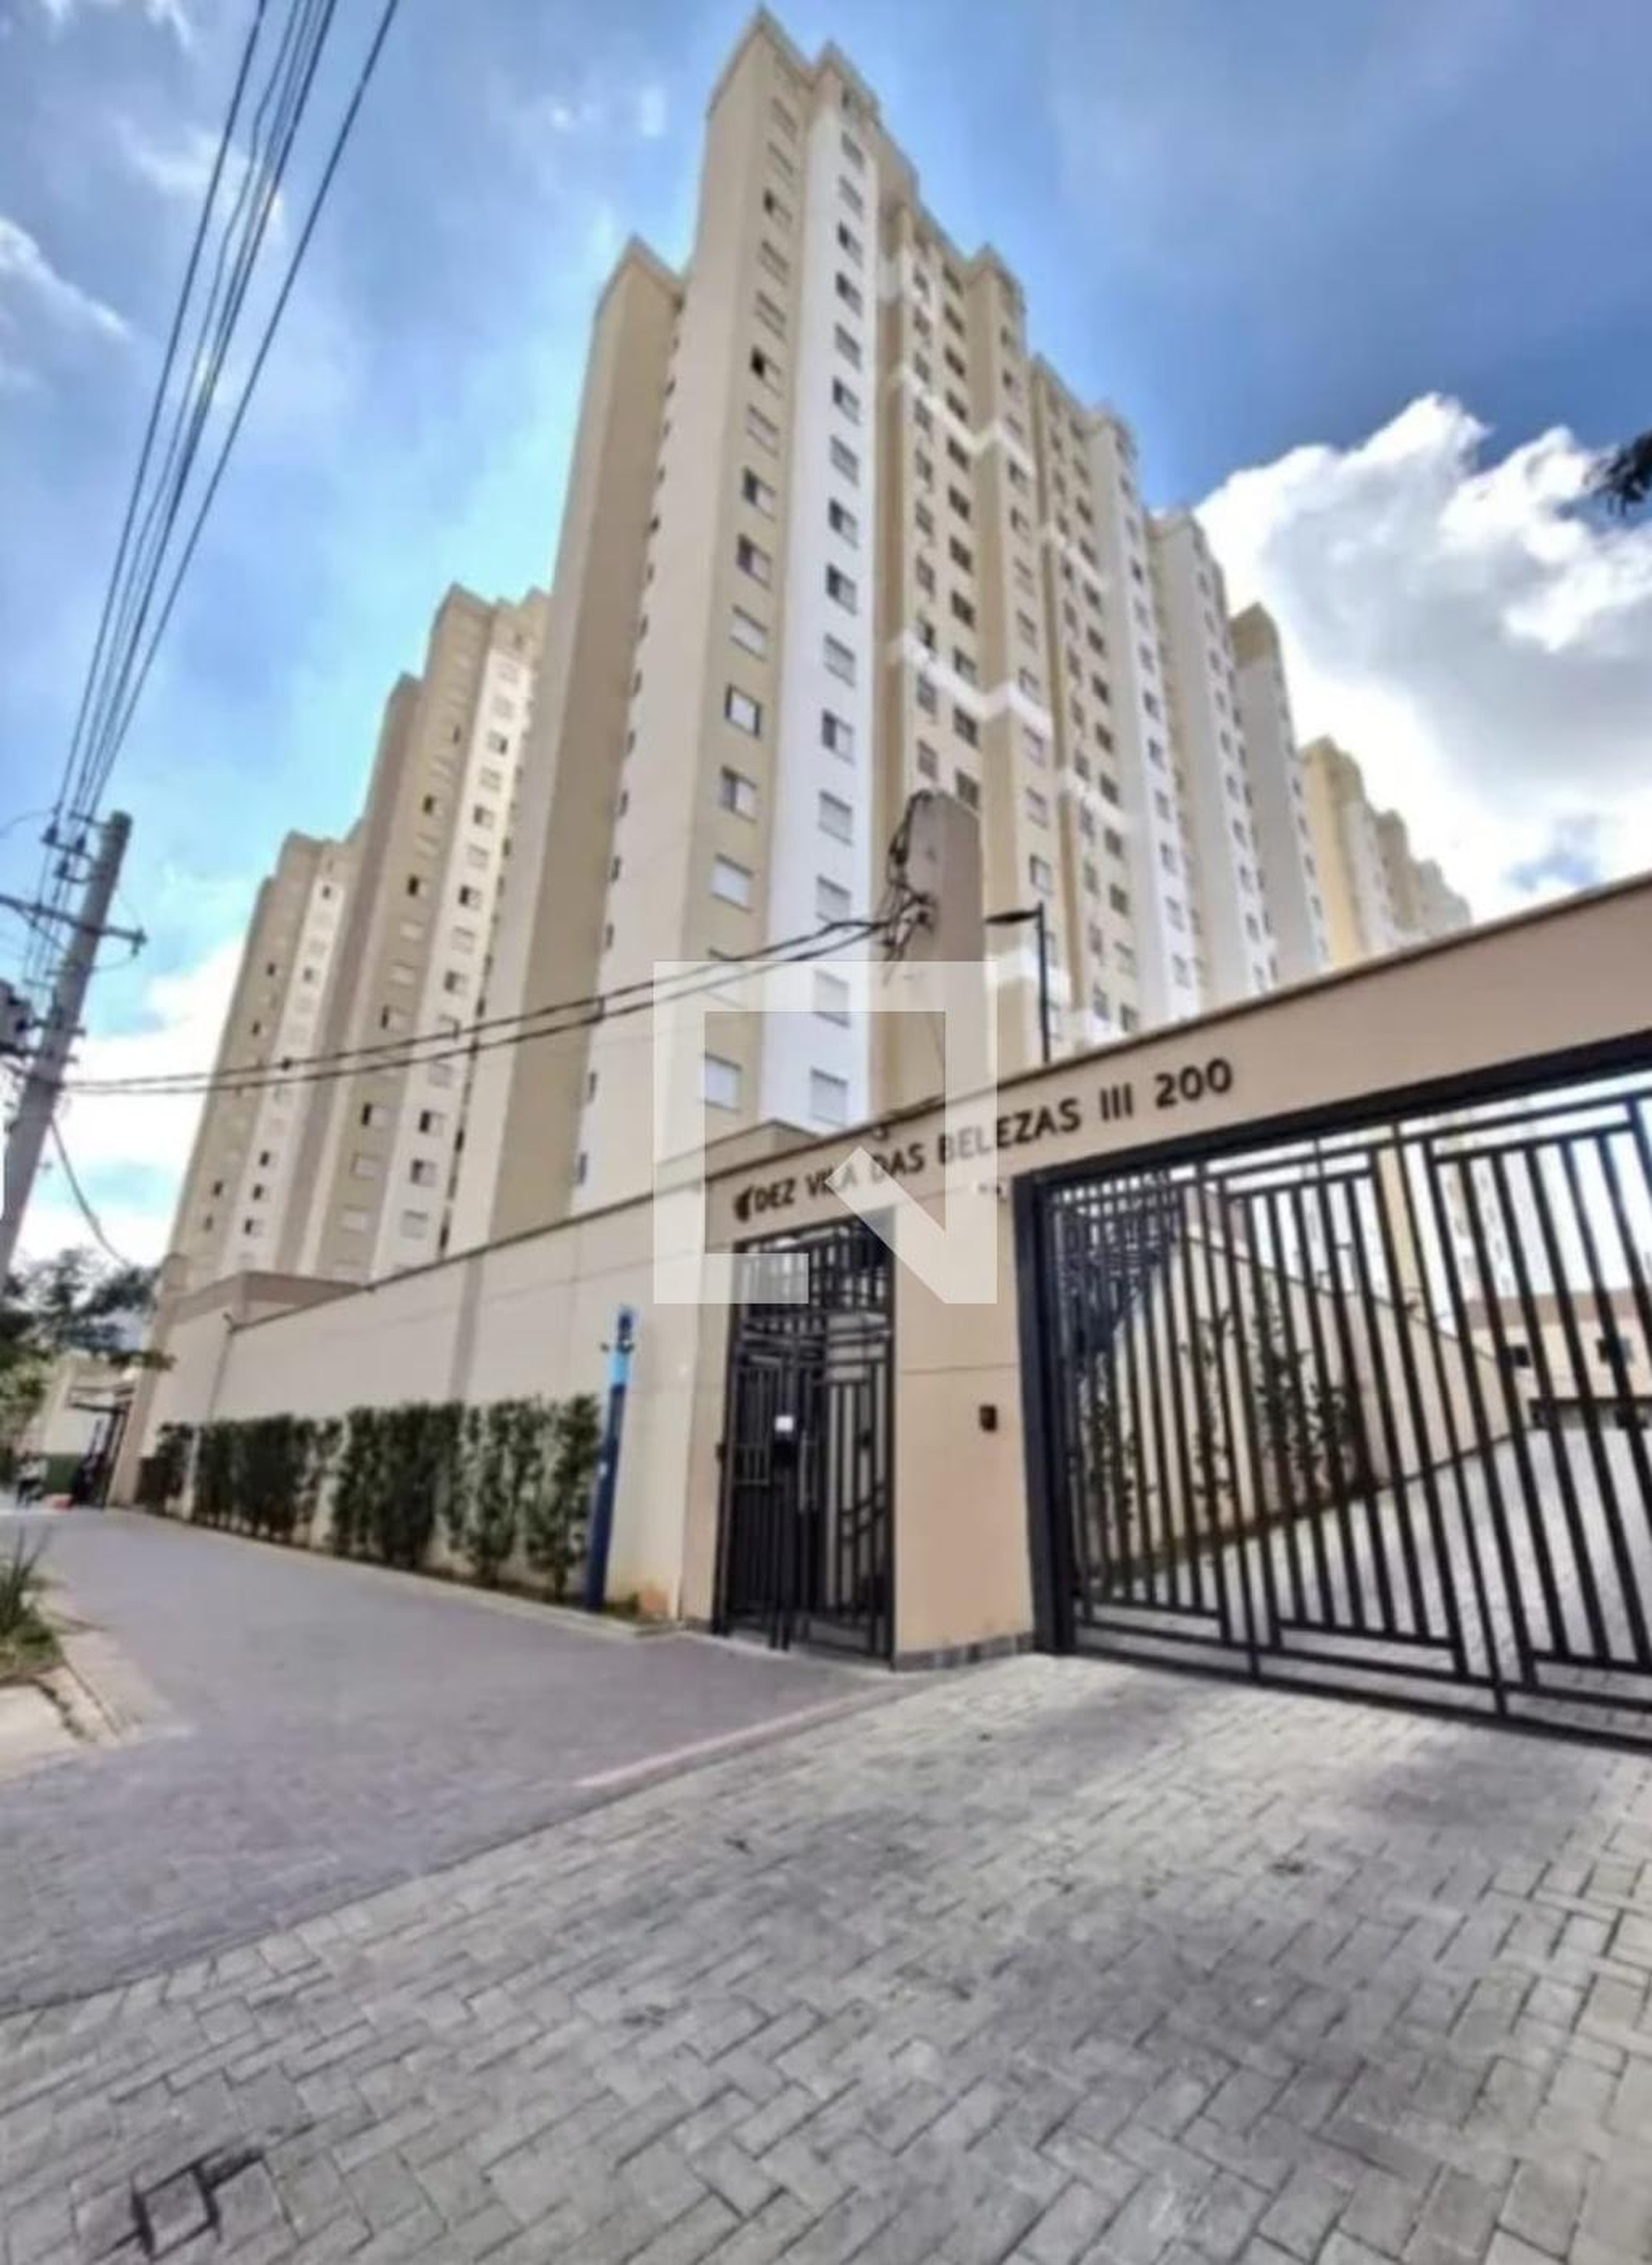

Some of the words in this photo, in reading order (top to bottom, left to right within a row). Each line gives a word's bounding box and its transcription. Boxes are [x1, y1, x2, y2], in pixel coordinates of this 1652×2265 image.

[753, 1177, 796, 1213] DEZ
[869, 1142, 925, 1184] DAS
[937, 1097, 1081, 1165] BELEZAS
[1100, 1083, 1134, 1121] III
[1155, 1058, 1233, 1109] 200
